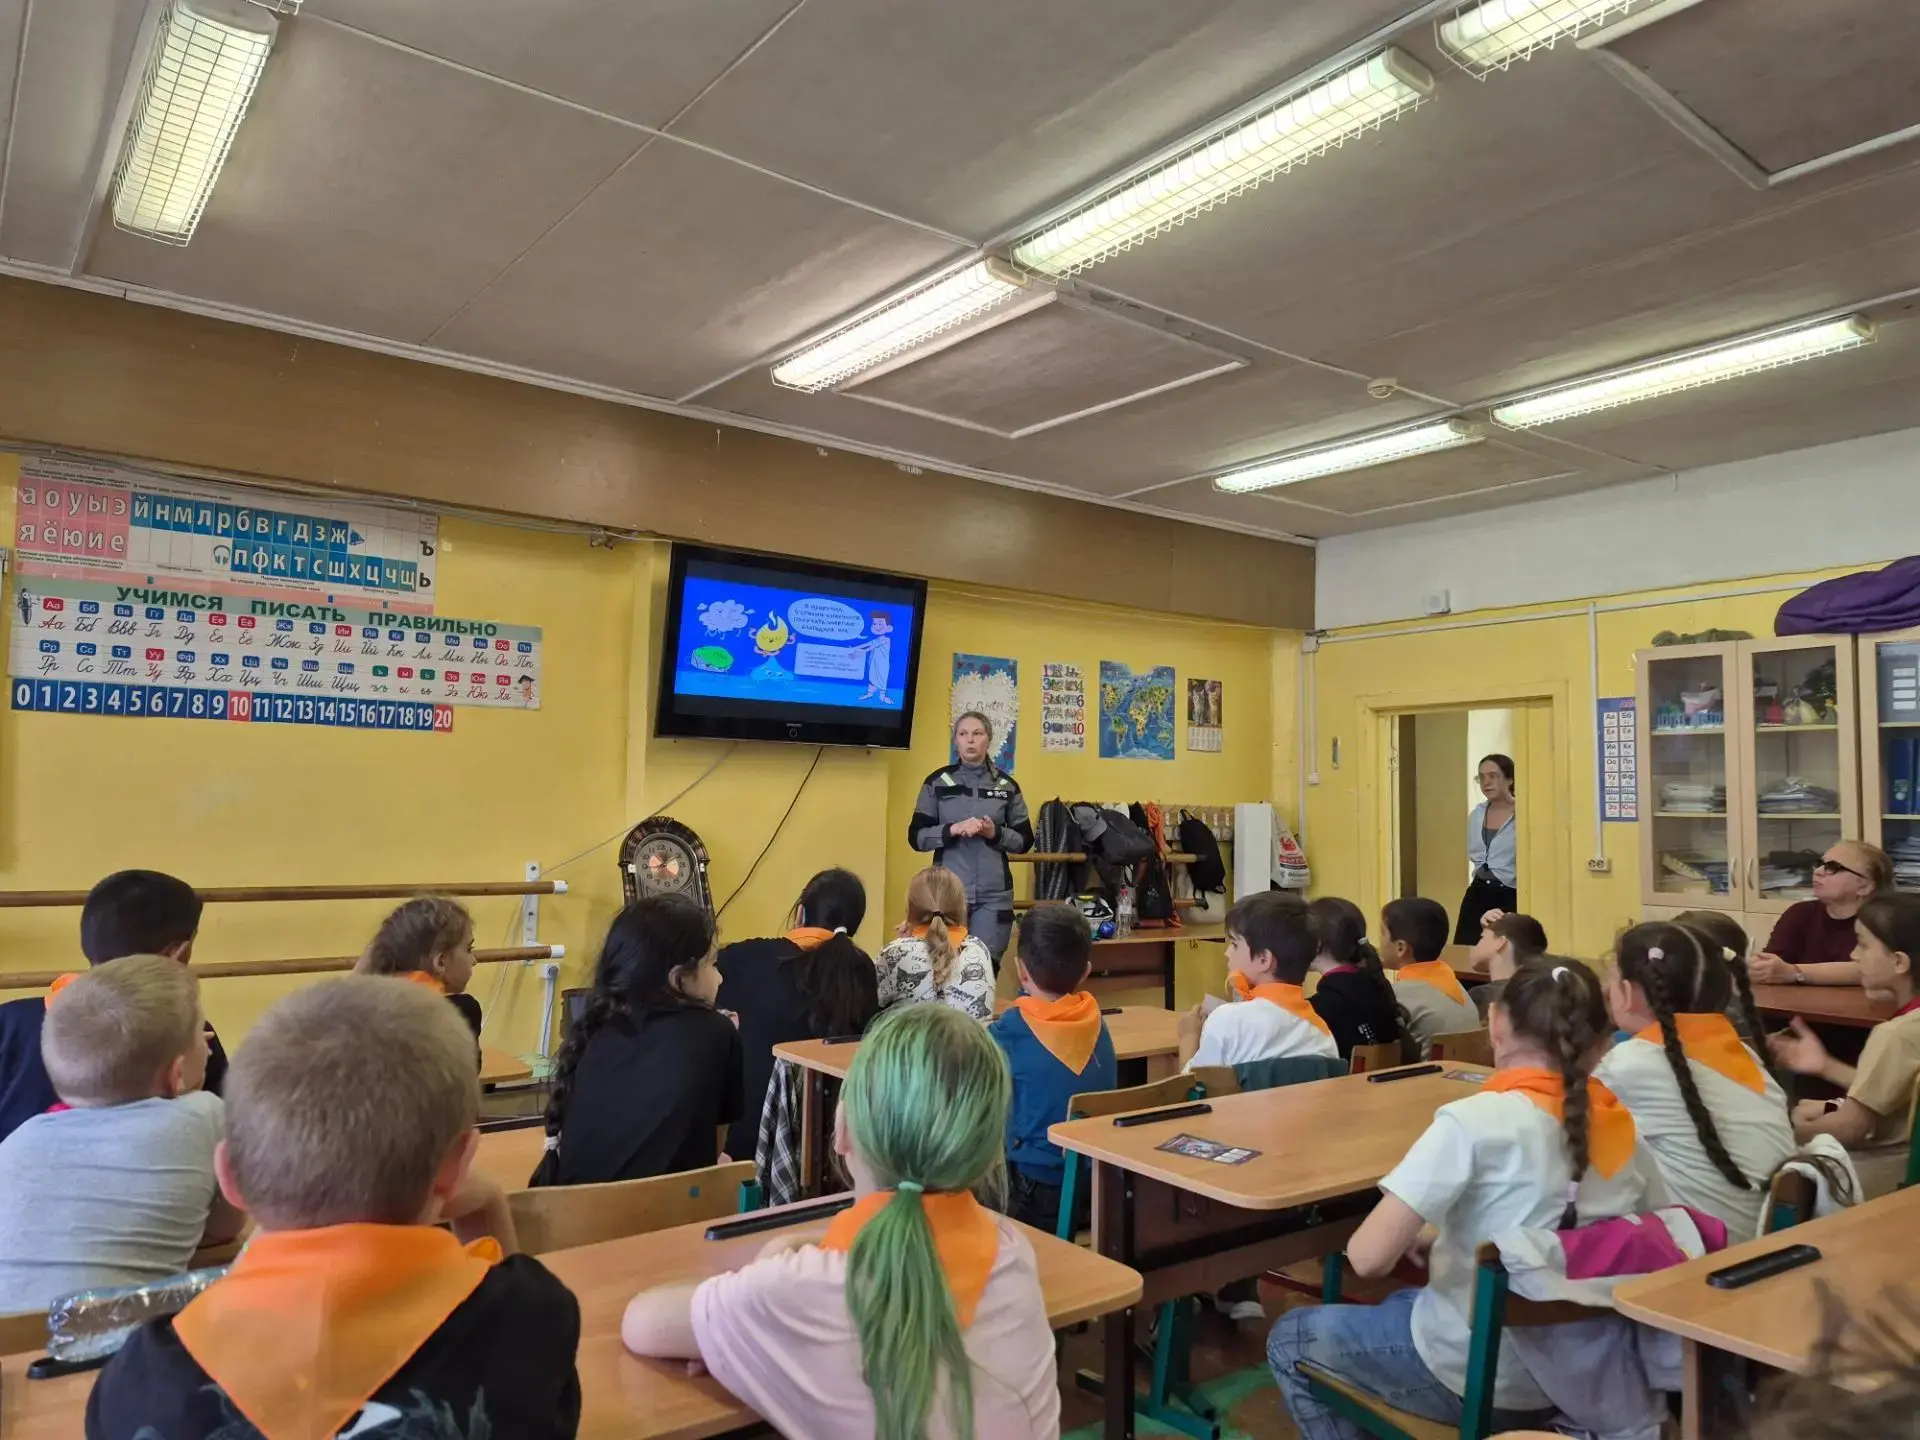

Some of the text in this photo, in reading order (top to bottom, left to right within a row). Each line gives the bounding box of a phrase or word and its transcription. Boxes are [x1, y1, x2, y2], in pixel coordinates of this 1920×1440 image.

[22, 487, 127, 515] а о у ы э
[134, 495, 148, 518] й
[156, 504, 169, 520] н
[174, 508, 192, 523] м
[197, 509, 211, 526] л
[217, 512, 230, 534] р
[237, 511, 250, 531] б
[256, 517, 269, 534] в
[277, 521, 287, 535] г
[294, 524, 308, 543] д
[315, 525, 326, 540] з
[331, 527, 346, 544] ж
[20, 519, 124, 552] я ё ю и е
[234, 550, 247, 565] п
[253, 547, 269, 573] ф
[274, 554, 285, 569] к
[294, 556, 305, 571] т
[314, 560, 323, 574] с
[329, 562, 345, 577] ш
[350, 564, 360, 579] х
[366, 565, 378, 585] ц
[386, 567, 396, 582] ч
[401, 568, 415, 590] щ
[116, 586, 498, 637] УЧИМСЯ ПИСАТЬ ПРАВИЛЬНО
[17, 684, 452, 728] 0 1 2 3 4 5 6 7 8 9 10 11 12 13 14 15 16 17 18 19 20
[1043, 721, 1084, 735] 9 10
